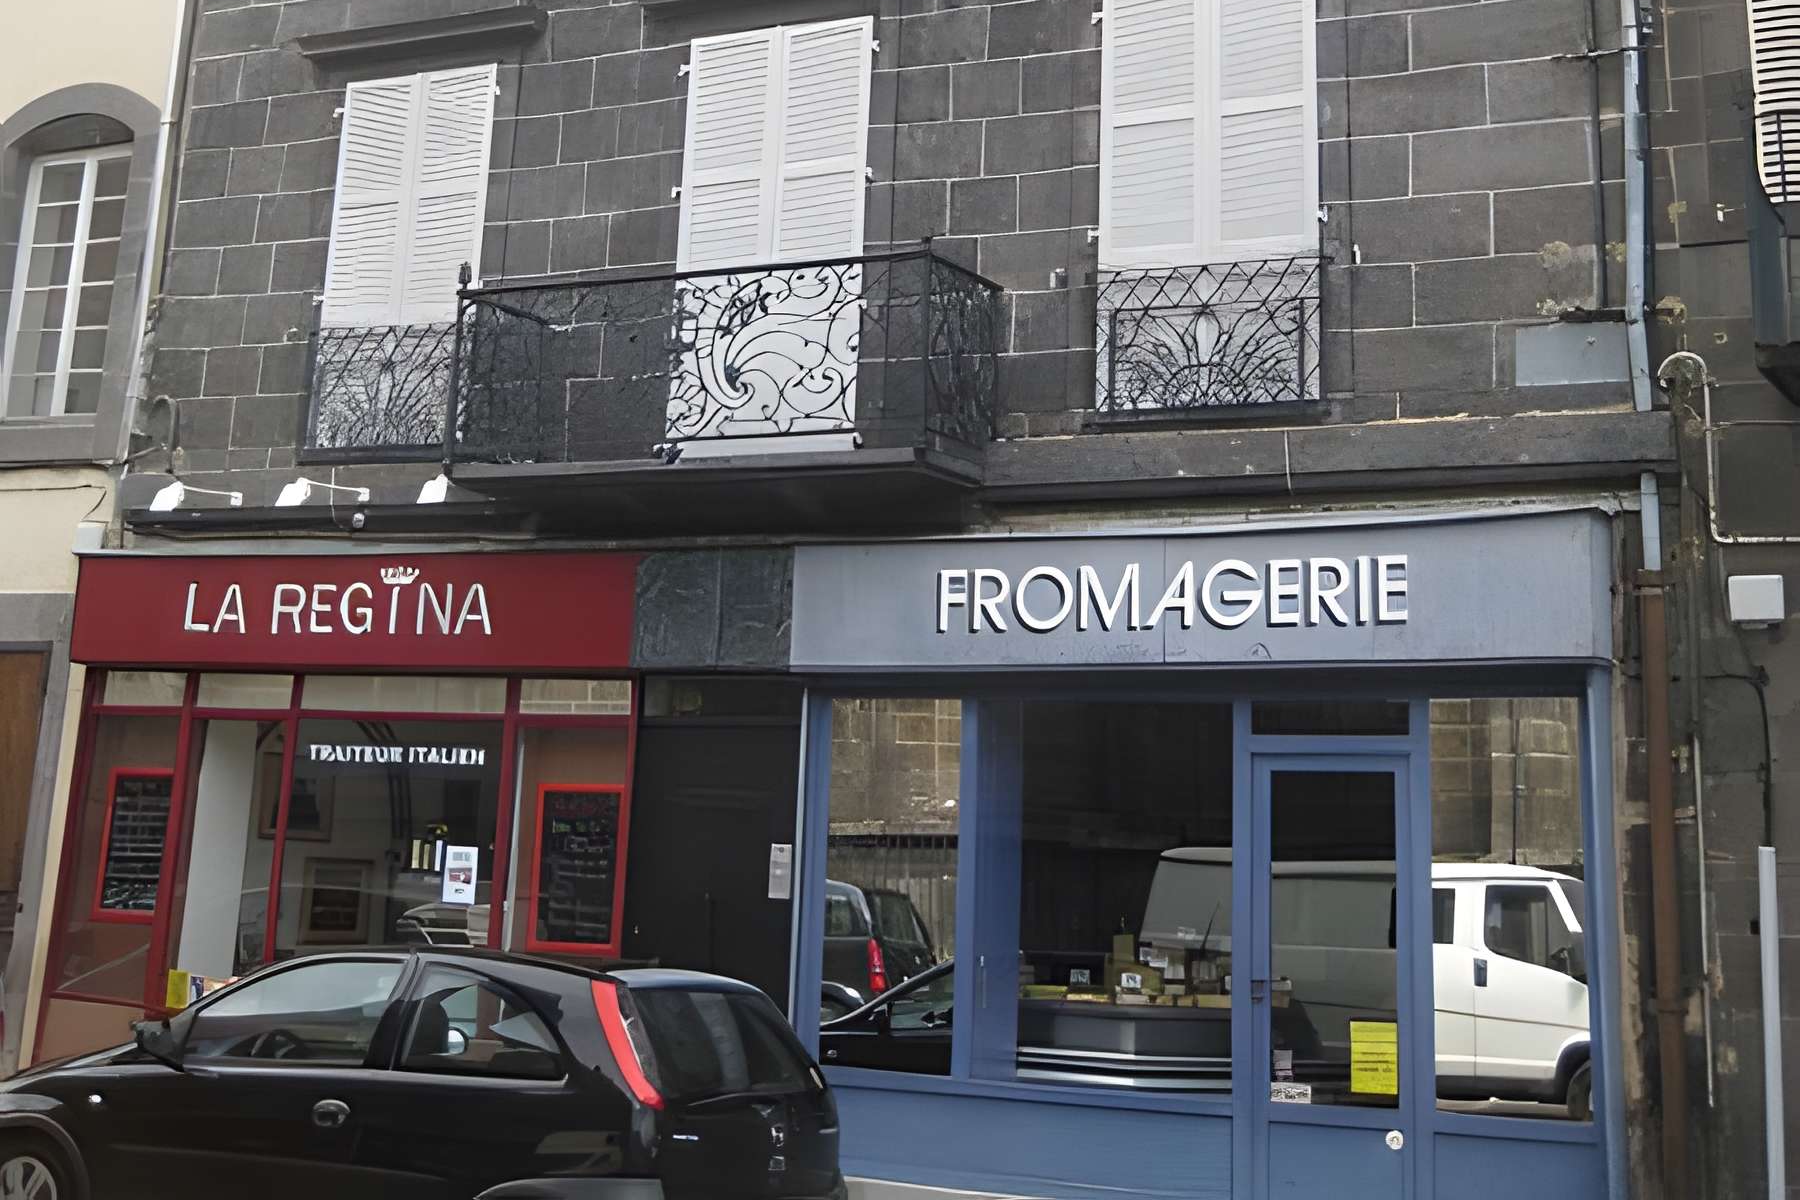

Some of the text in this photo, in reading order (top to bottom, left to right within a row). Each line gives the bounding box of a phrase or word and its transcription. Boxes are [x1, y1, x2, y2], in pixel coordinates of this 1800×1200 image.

[184, 582, 492, 635] LA REGINA
[936, 554, 1409, 633] FROMAGERIE
